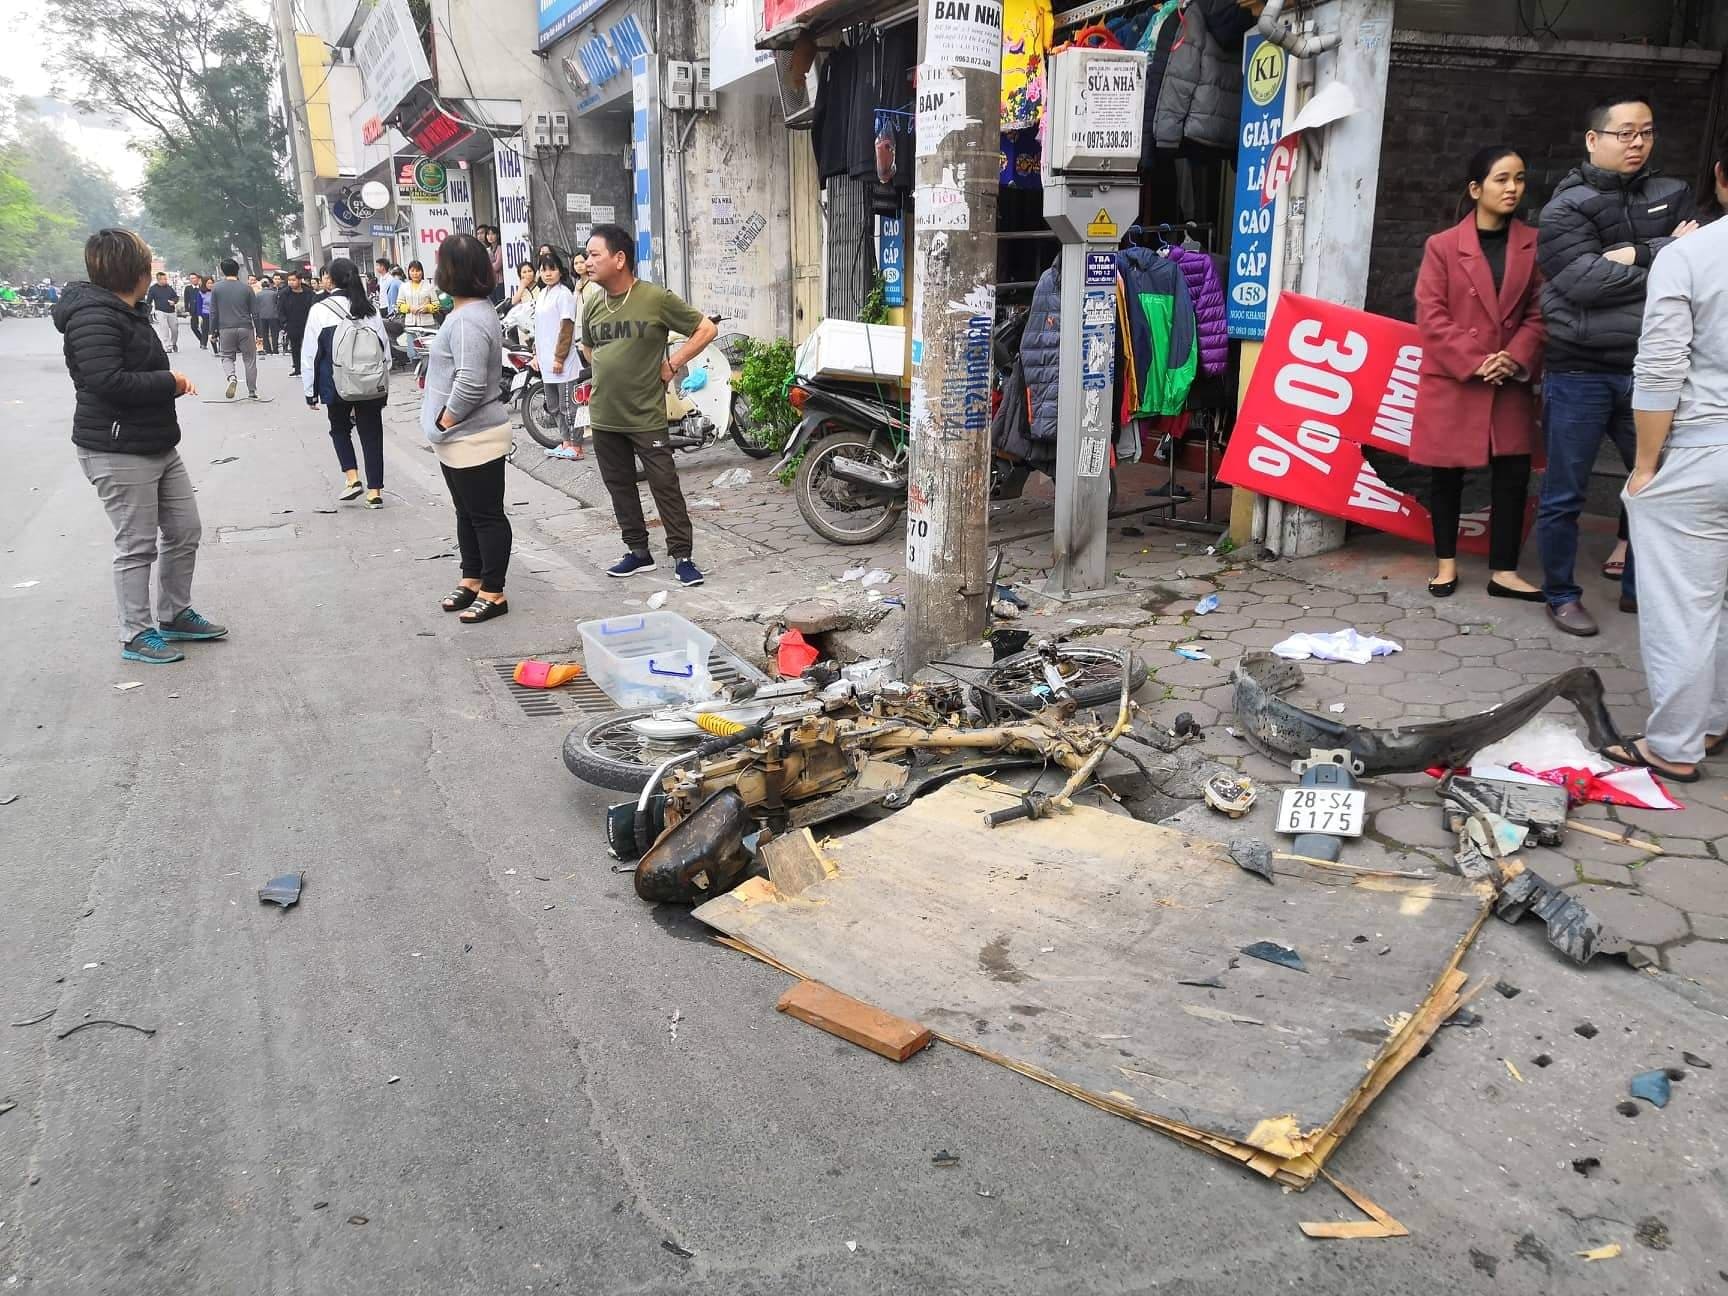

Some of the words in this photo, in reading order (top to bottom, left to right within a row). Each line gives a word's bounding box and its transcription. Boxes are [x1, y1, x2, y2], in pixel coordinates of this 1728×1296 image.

[1254, 55, 1280, 82] KL
[1088, 72, 1110, 91] SỬA
[1113, 72, 1135, 91] NHÀ
[1087, 131, 1132, 148] 0975.338.291
[1243, 112, 1281, 152] GIẶT
[450, 176, 469, 203] NHÀ
[884, 220, 900, 236] CAO
[1239, 208, 1271, 234] CAO
[1236, 240, 1267, 276] CẤP
[1239, 286, 1261, 301] 158
[1248, 319, 1368, 477] 30%
[1292, 790, 1353, 810] 28-S4
[1289, 810, 1352, 831] 6175
